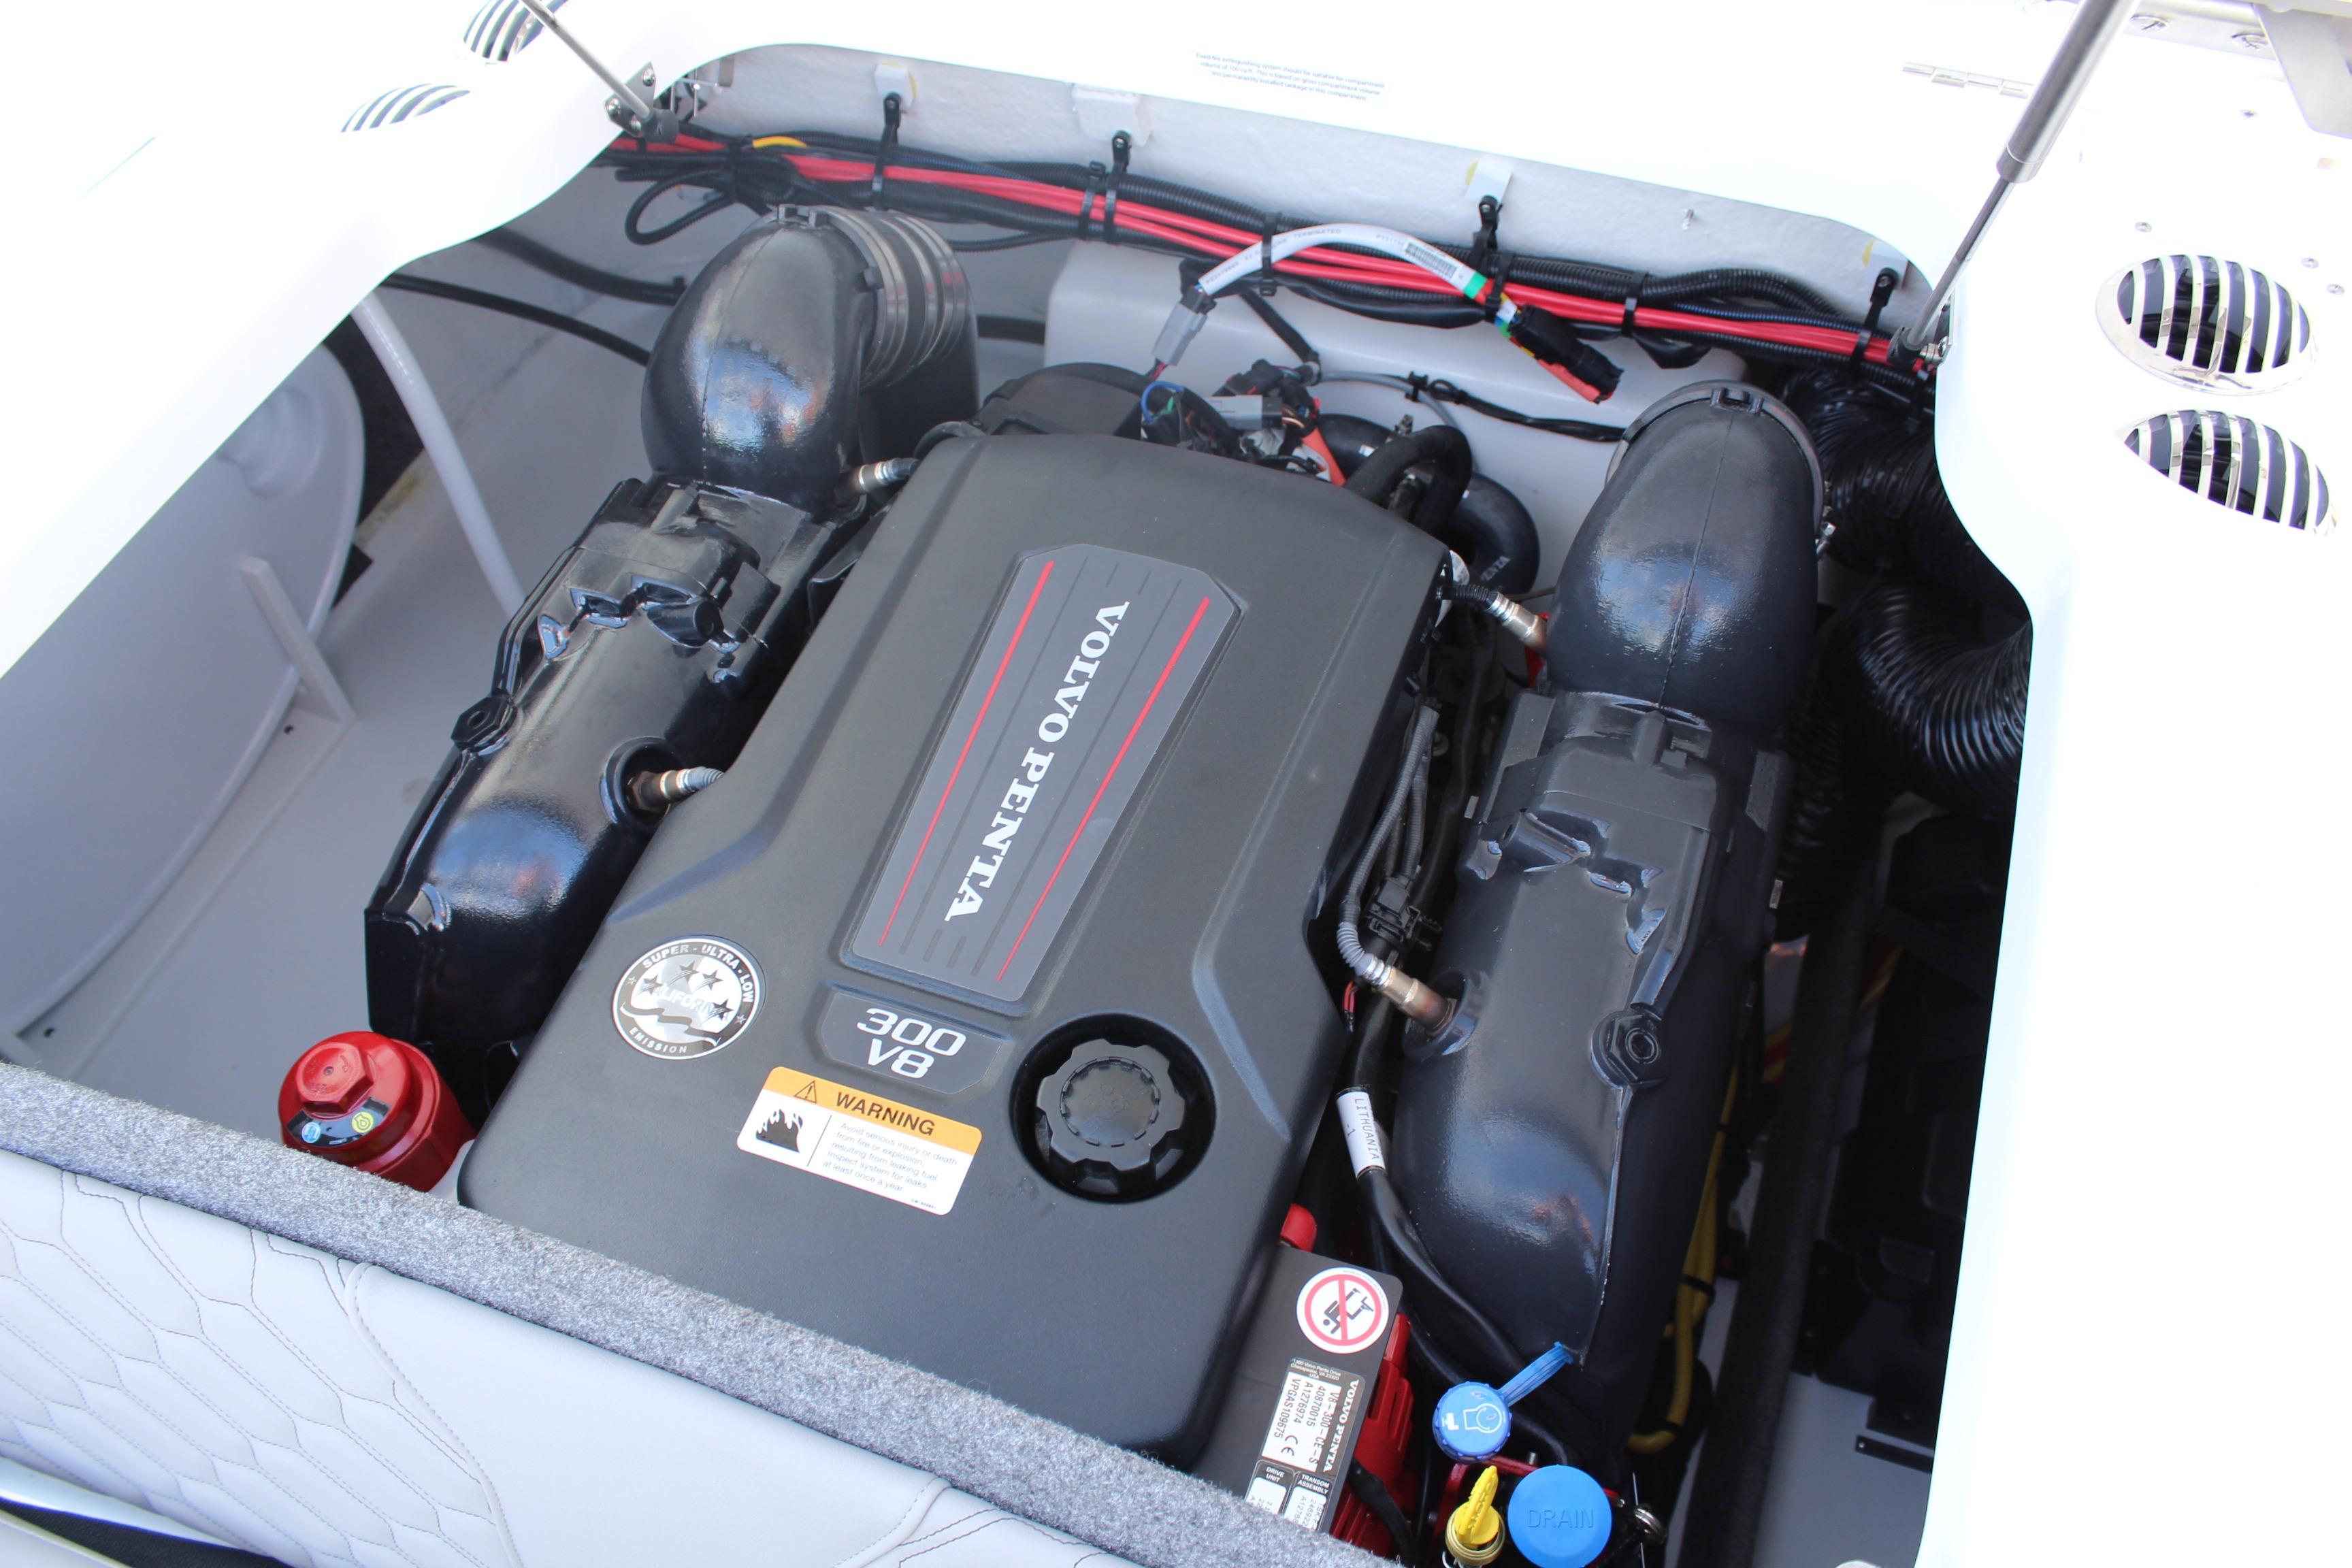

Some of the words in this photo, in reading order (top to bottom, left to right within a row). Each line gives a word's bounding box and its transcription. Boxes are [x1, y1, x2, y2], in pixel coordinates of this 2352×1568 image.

[1200, 61, 1221, 69] volume
[1273, 72, 1292, 80] based
[1317, 80, 1357, 91] compartment
[1358, 86, 1380, 95] volume
[1262, 63, 1281, 71] system
[1282, 66, 1302, 74] should
[1312, 71, 1334, 80] suitable
[1345, 76, 1384, 88] compartment
[1039, 602, 1130, 742] VOLVO
[944, 747, 1054, 921] PENTA
[642, 944, 689, 969] SUPER
[701, 944, 740, 970] ULTRA
[740, 974, 755, 1003] LOW
[628, 1026, 687, 1054] EMISSION
[857, 1008, 966, 1056] 300
[868, 1038, 934, 1079] V8
[836, 1092, 935, 1136] WARNING
[1354, 1098, 1379, 1160] LITHUANIA
[832, 1143, 866, 1159] resulting
[869, 1154, 888, 1164] from
[889, 1159, 919, 1176] leaking
[836, 1132, 855, 1143] from
[858, 1139, 870, 1148] fire
[840, 1123, 864, 1135] Avoid
[866, 1130, 895, 1145] serious
[898, 1139, 921, 1154] injury
[933, 1153, 958, 1165] death
[828, 1151, 858, 1166] Inspect
[860, 1161, 889, 1176] system
[892, 1171, 904, 1180] for
[905, 1177, 927, 1188] leaks
[833, 1163, 853, 1175] least
[854, 1172, 875, 1181] once
[1274, 1379, 1301, 1439] VPGAS109675
[1293, 1381, 1313, 1424] A1276974
[1307, 1386, 1326, 1427] 40870015
[1339, 1379, 1359, 1423] VOLVO
[1323, 1424, 1345, 1472] PENTA
[1266, 1466, 1285, 1477] DRIVE
[1266, 1473, 1281, 1483] UNIT
[1297, 1480, 1328, 1494] ASSEMBLY
[1301, 1474, 1330, 1488] TRANSOM
[1526, 1507, 1595, 1528] DRAIN
